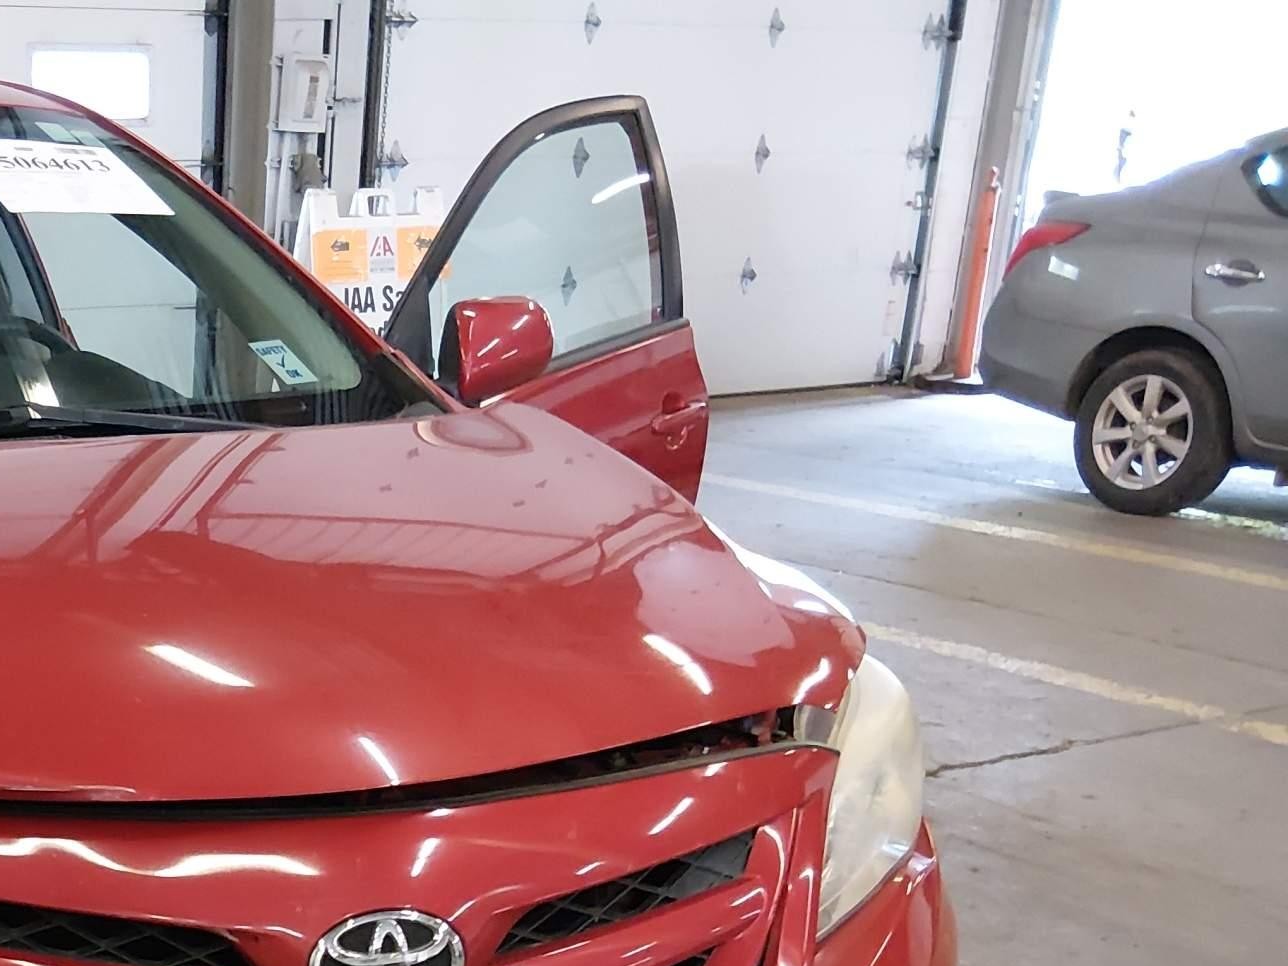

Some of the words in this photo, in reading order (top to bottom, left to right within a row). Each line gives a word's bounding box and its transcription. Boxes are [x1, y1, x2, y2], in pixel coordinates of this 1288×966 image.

[344, 286, 376, 313] IAA
[255, 345, 288, 356] SAFETY
[285, 369, 303, 378] OK
